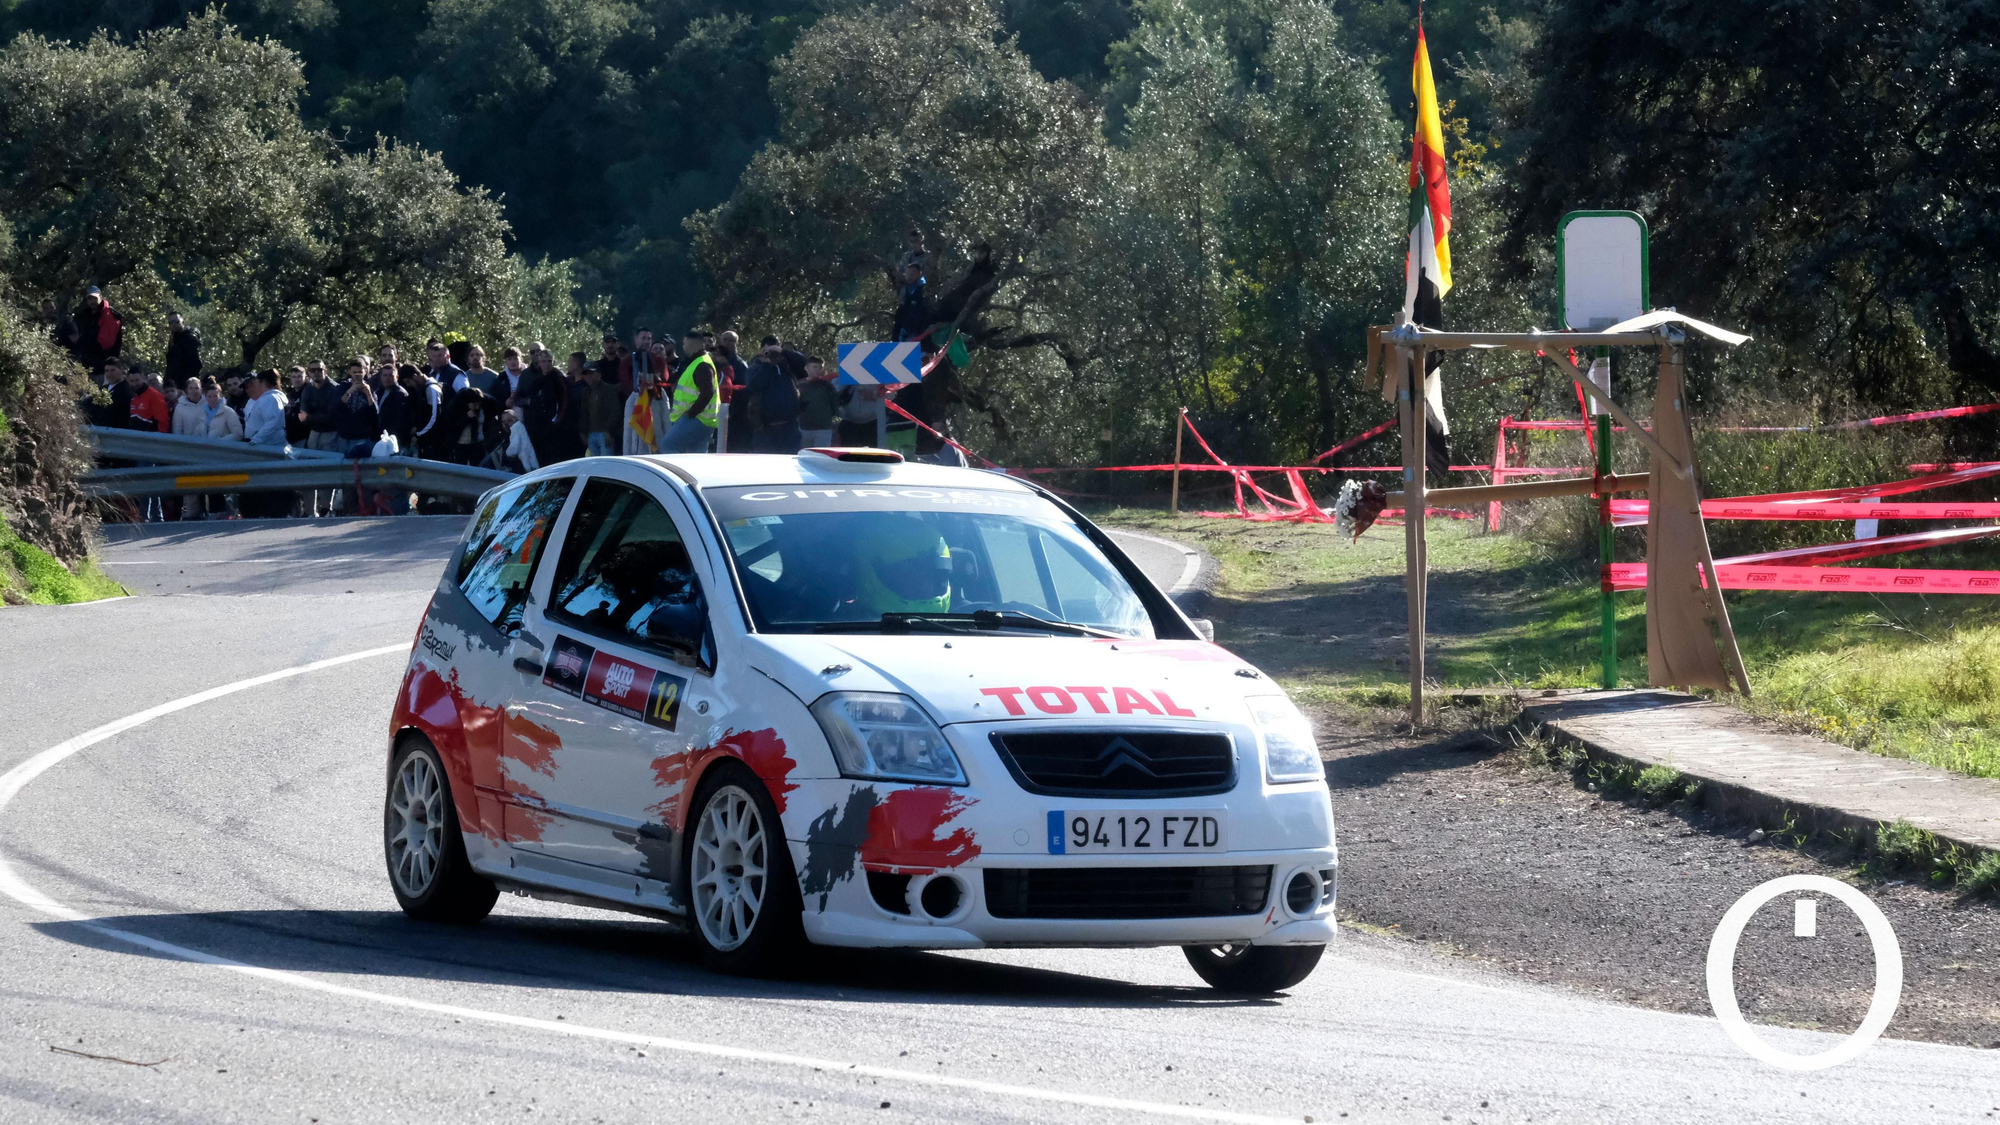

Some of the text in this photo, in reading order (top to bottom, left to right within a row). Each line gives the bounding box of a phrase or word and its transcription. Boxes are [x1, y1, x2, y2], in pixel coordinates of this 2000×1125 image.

[606, 662, 635, 685] AUTO
[601, 678, 631, 699] SPORT
[653, 681, 678, 722] 12
[979, 686, 1197, 718] TOTAL
[1053, 836, 1061, 845] E
[1071, 816, 1219, 848] 9412 FZD
